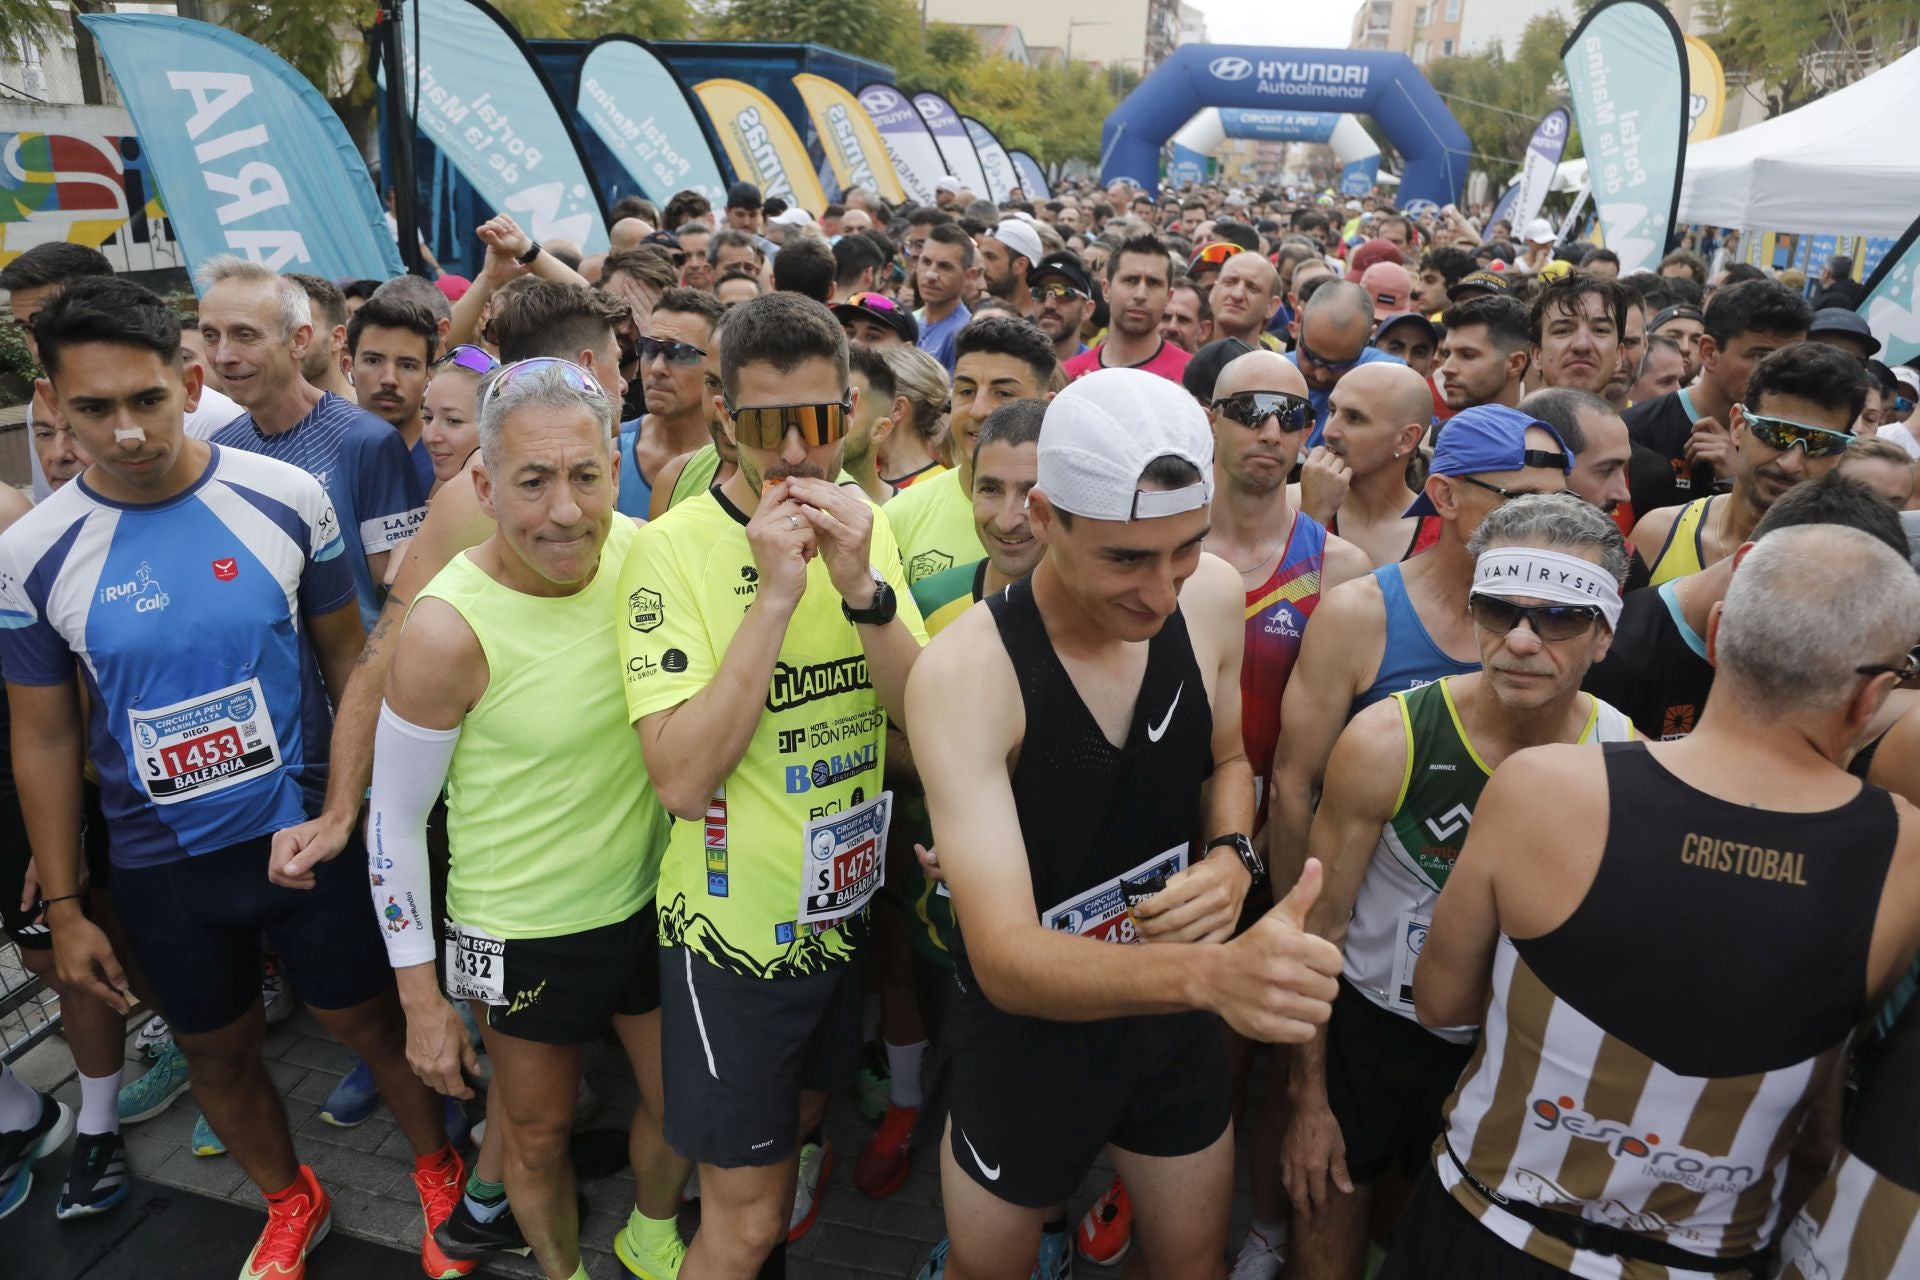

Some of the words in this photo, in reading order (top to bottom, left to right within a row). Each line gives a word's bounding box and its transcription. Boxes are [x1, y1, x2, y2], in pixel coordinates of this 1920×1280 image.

[1257, 61, 1369, 85] HYUNDAI
[1257, 78, 1367, 99] Autoalmenar
[383, 519, 405, 531] LA
[407, 510, 429, 524] CAR
[1484, 563, 1520, 580] VAN
[1539, 567, 1602, 599] RYSEL
[136, 594, 170, 613] Calp
[638, 669, 658, 680] GROUP
[769, 660, 870, 707] GLADIATO
[155, 711, 193, 729] CIRCUIT
[194, 709, 203, 719] A
[203, 703, 222, 716] PEU
[164, 721, 197, 735] MARINA
[199, 713, 221, 725] ALTA
[810, 721, 829, 732] HOTEL
[182, 726, 209, 739] DIEGO
[811, 727, 840, 748] DON
[842, 713, 884, 740] PANCHO
[147, 757, 161, 776] S
[168, 735, 239, 774] 1453
[174, 758, 245, 789] BALEARIA
[836, 819, 858, 835] CIRCUIT
[847, 834, 865, 849] VICENTE
[818, 869, 830, 891] S
[838, 846, 873, 888] 1475
[1680, 832, 1808, 886] CRISTOBAL
[835, 875, 873, 905] BALEARIA
[1084, 889, 1121, 911] CIRCUIT
[1132, 874, 1150, 885] EU
[405, 891, 424, 931] CorreMundos
[1091, 898, 1122, 916] MARINA
